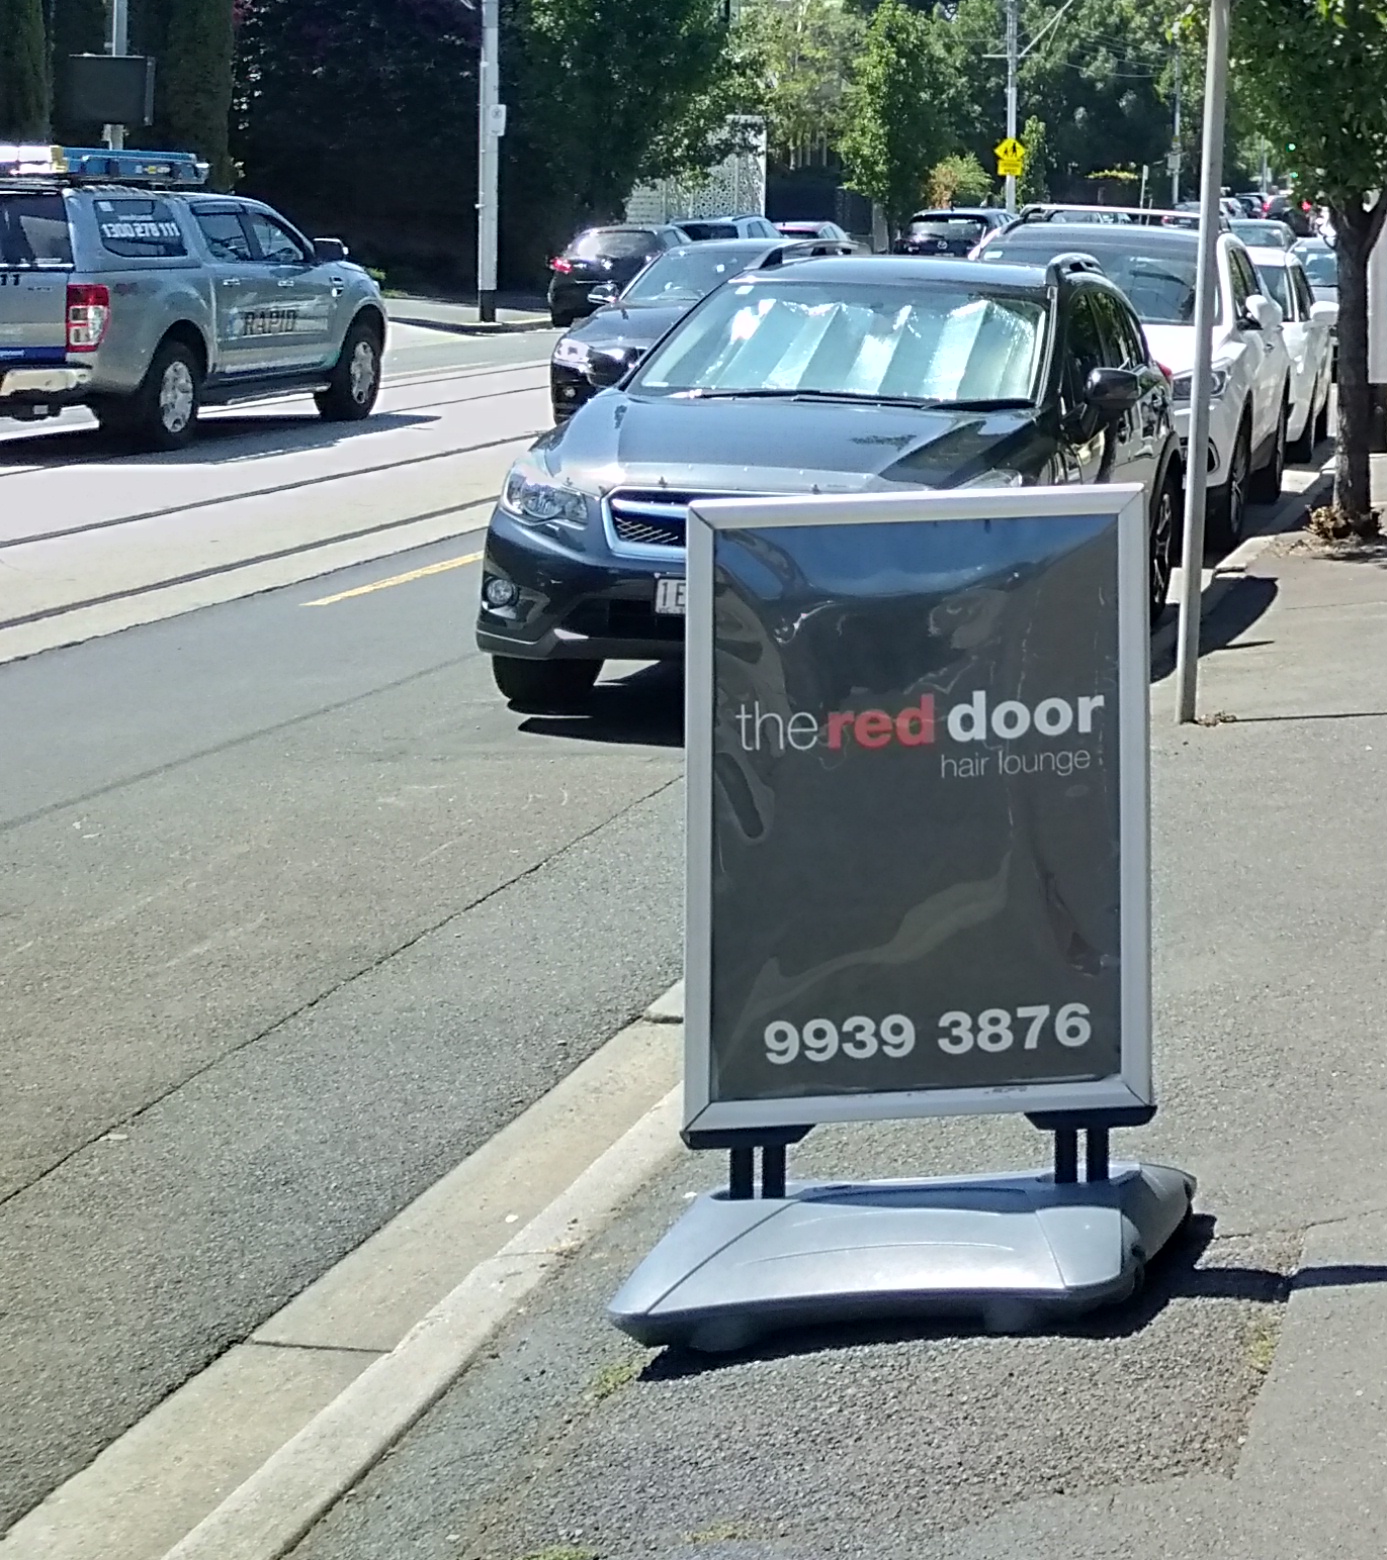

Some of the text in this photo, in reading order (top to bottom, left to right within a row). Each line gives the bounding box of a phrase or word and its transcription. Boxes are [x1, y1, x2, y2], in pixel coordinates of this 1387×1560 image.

[243, 310, 297, 335] RAPID
[736, 690, 1105, 751] the red door
[940, 748, 1091, 779] hair lounge
[764, 1003, 1092, 1065] 9939 3876
